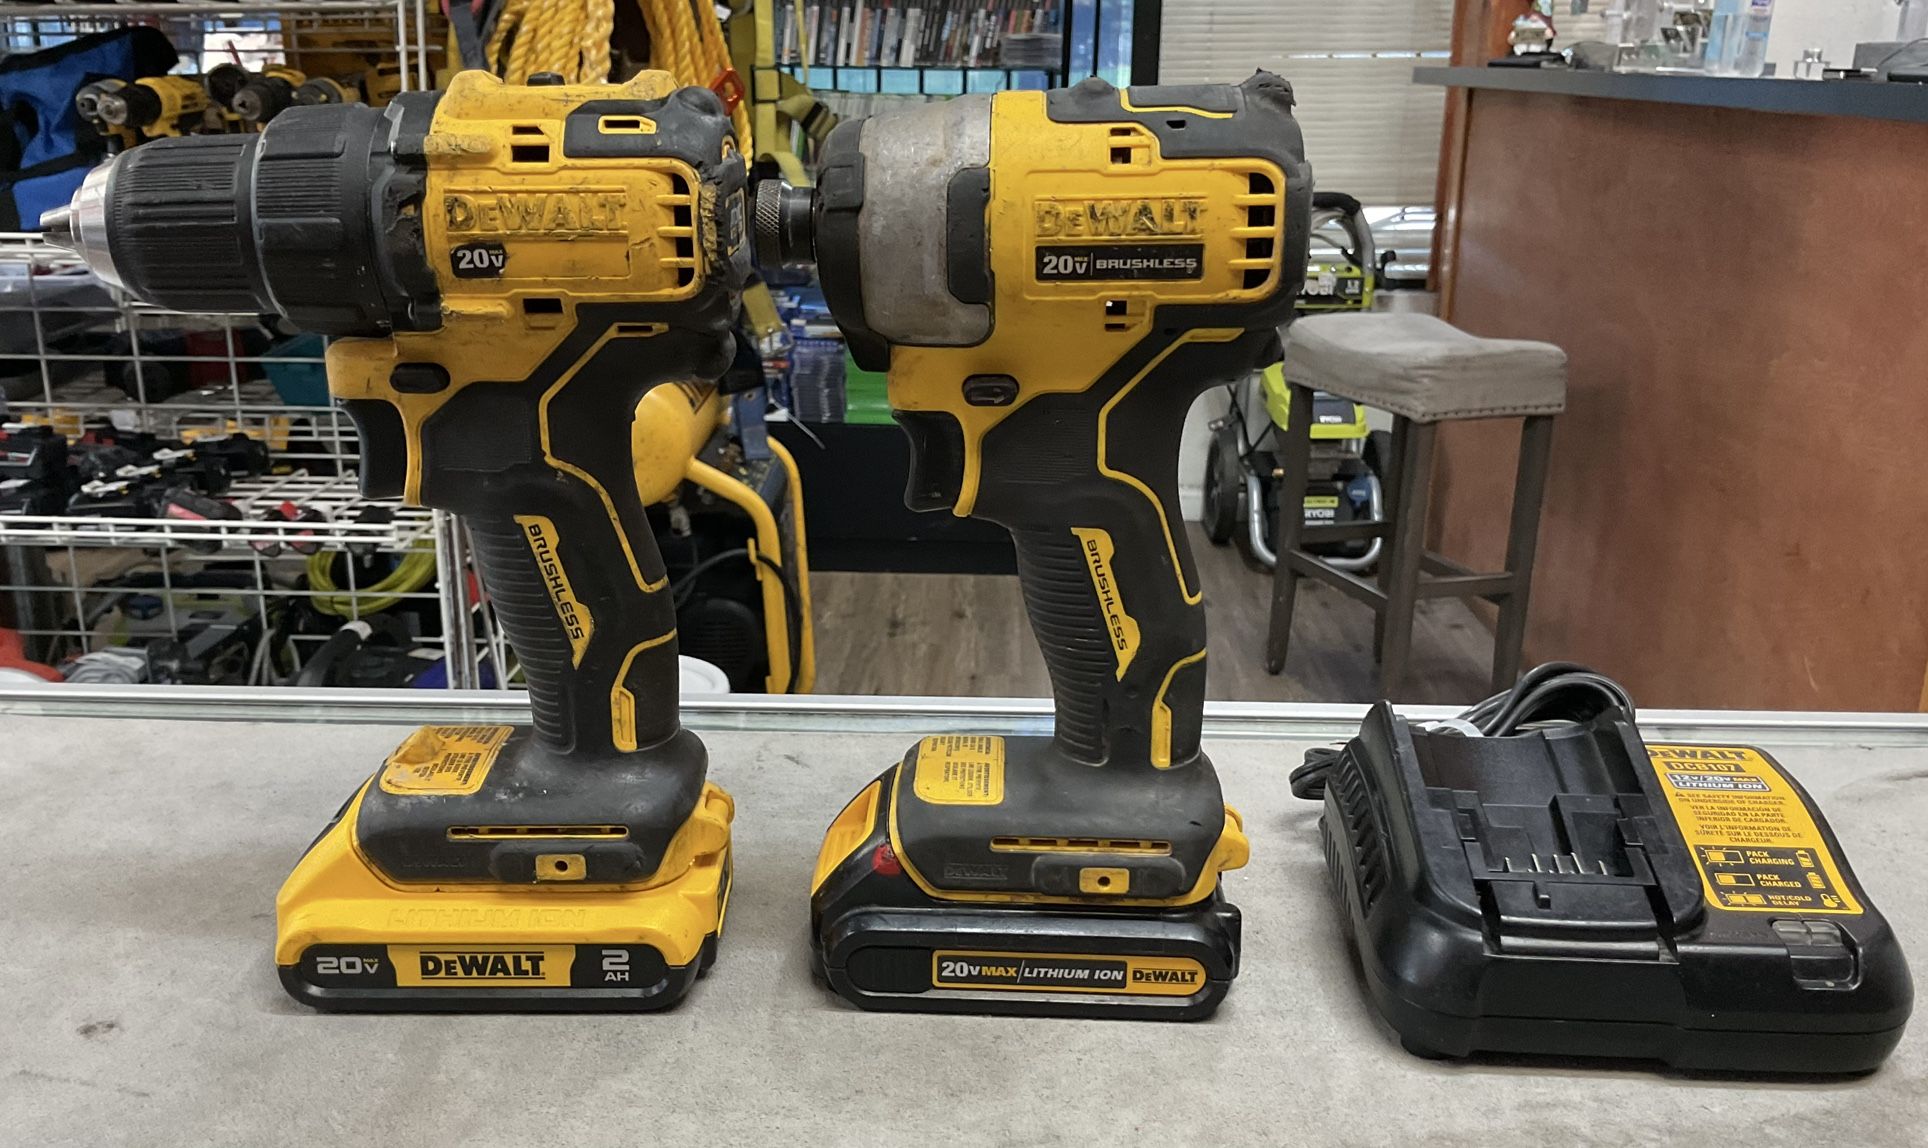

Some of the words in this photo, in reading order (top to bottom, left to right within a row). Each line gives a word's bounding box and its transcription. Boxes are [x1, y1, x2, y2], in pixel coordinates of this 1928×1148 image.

[1095, 258, 1197, 269] BRUSHLESS
[528, 523, 585, 640] BRUSHLESS
[1087, 539, 1128, 651] BRUSHLESS
[1669, 762, 1737, 772] DCB107
[1678, 781, 1734, 789] LITHIUM
[1749, 857, 1795, 865] CHARGING
[1760, 880, 1802, 888] CHARGED
[420, 954, 545, 977] DEWALT
[601, 949, 630, 971] 2
[604, 971, 630, 982] AH
[1023, 967, 1092, 980] LITHIUM
[1094, 969, 1125, 981] ION
[1132, 968, 1198, 983] DEWALT
